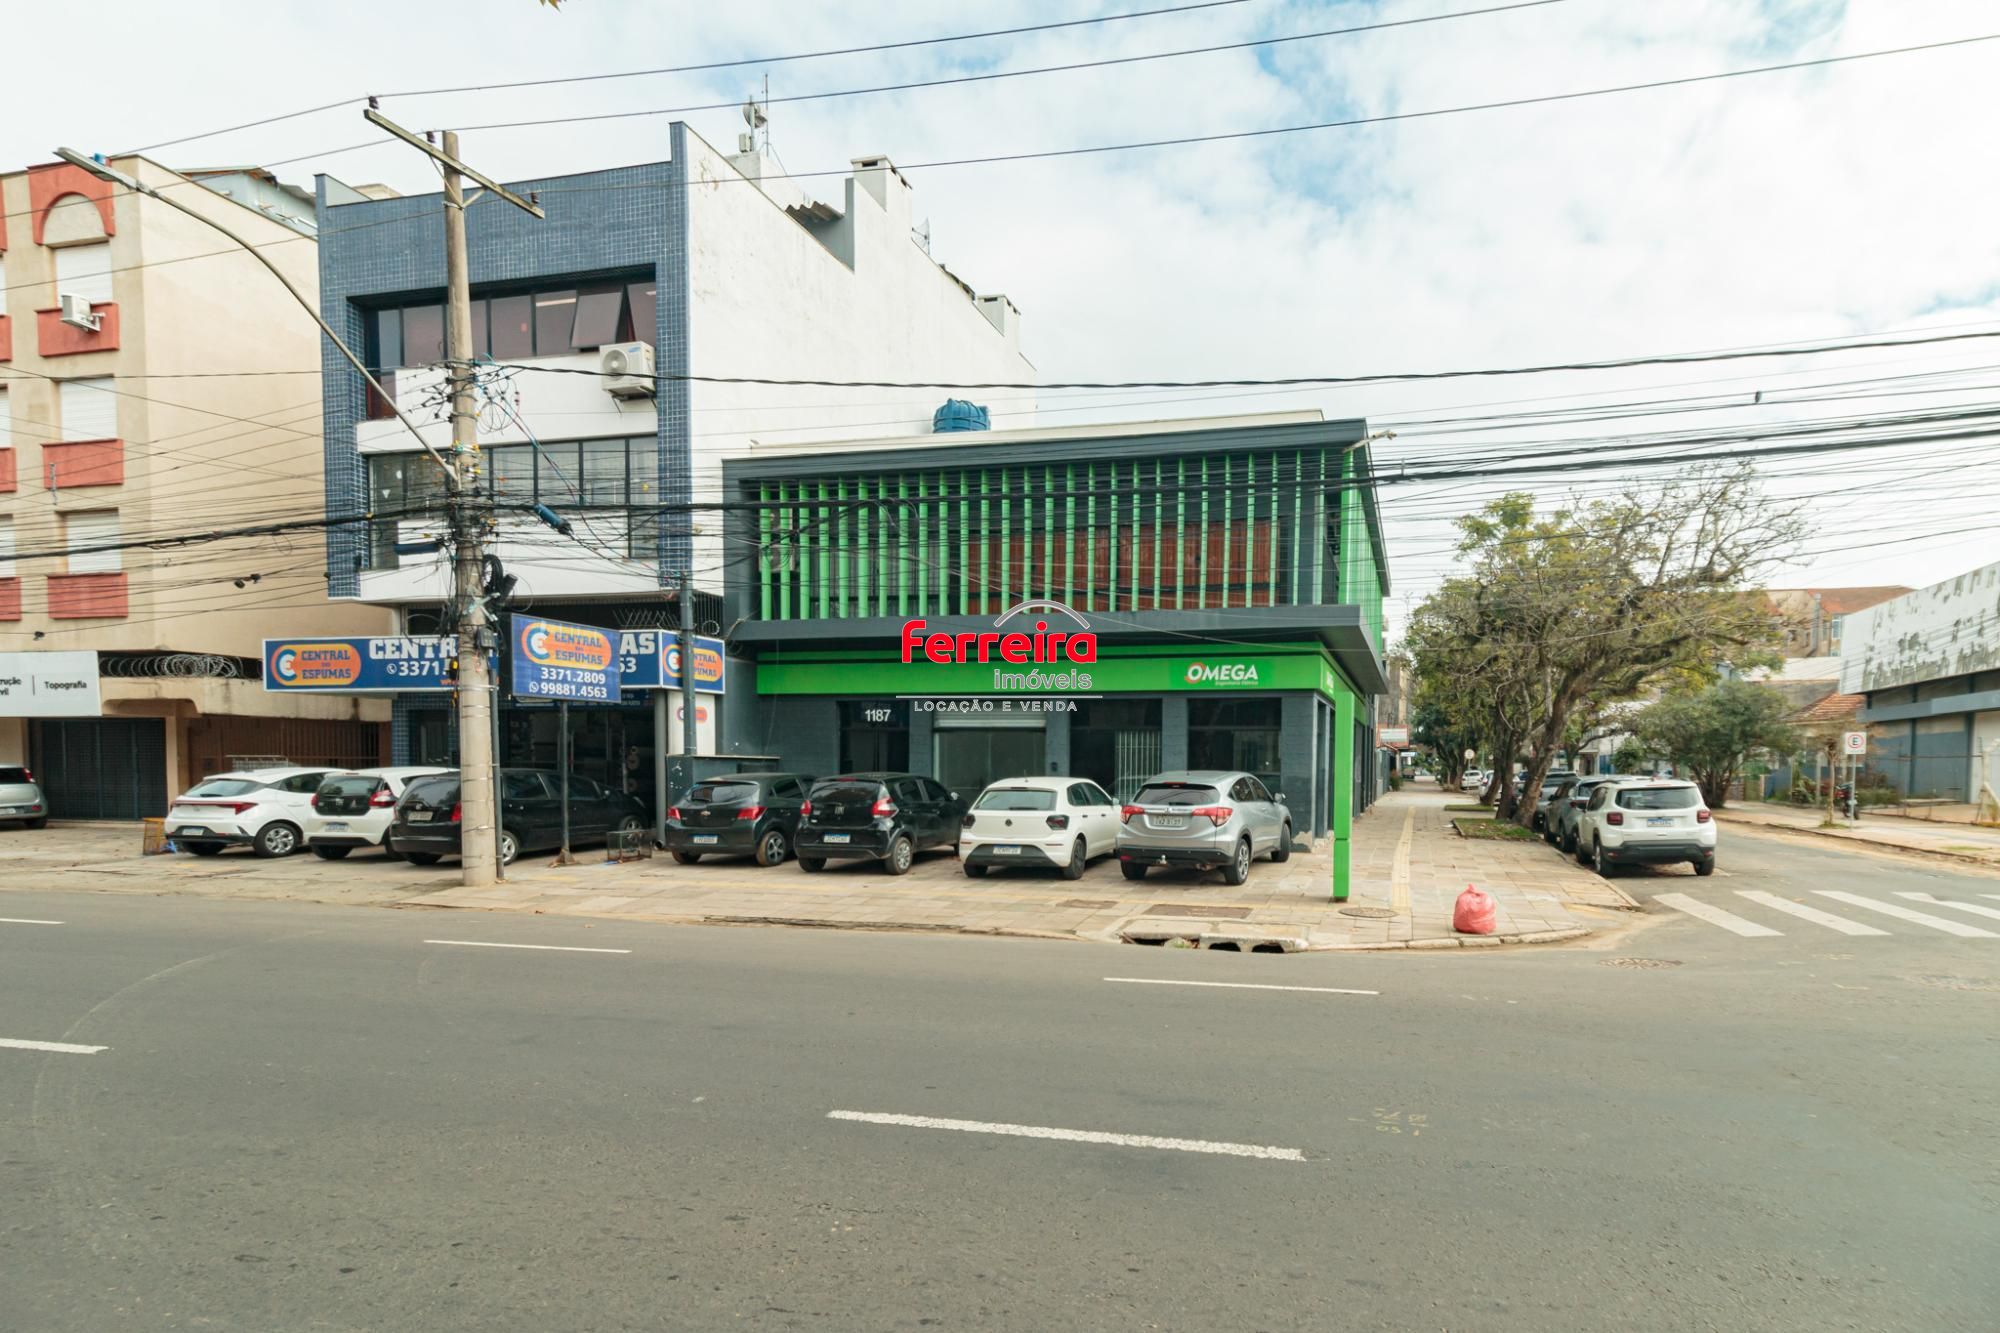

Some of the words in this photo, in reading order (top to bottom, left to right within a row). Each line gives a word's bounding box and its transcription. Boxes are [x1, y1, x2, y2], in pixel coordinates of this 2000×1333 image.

[554, 631, 602, 648] CENTRAL
[301, 650, 350, 661] CENTRAL
[555, 649, 603, 665] ESPUMAS
[302, 668, 351, 680] ESPUMAS
[541, 667, 606, 685] 3371.2809
[1187, 664, 1259, 681] OMEGA
[44, 681, 87, 691] Topografia
[541, 682, 607, 698] 99881.4563
[865, 709, 891, 722] 1187
